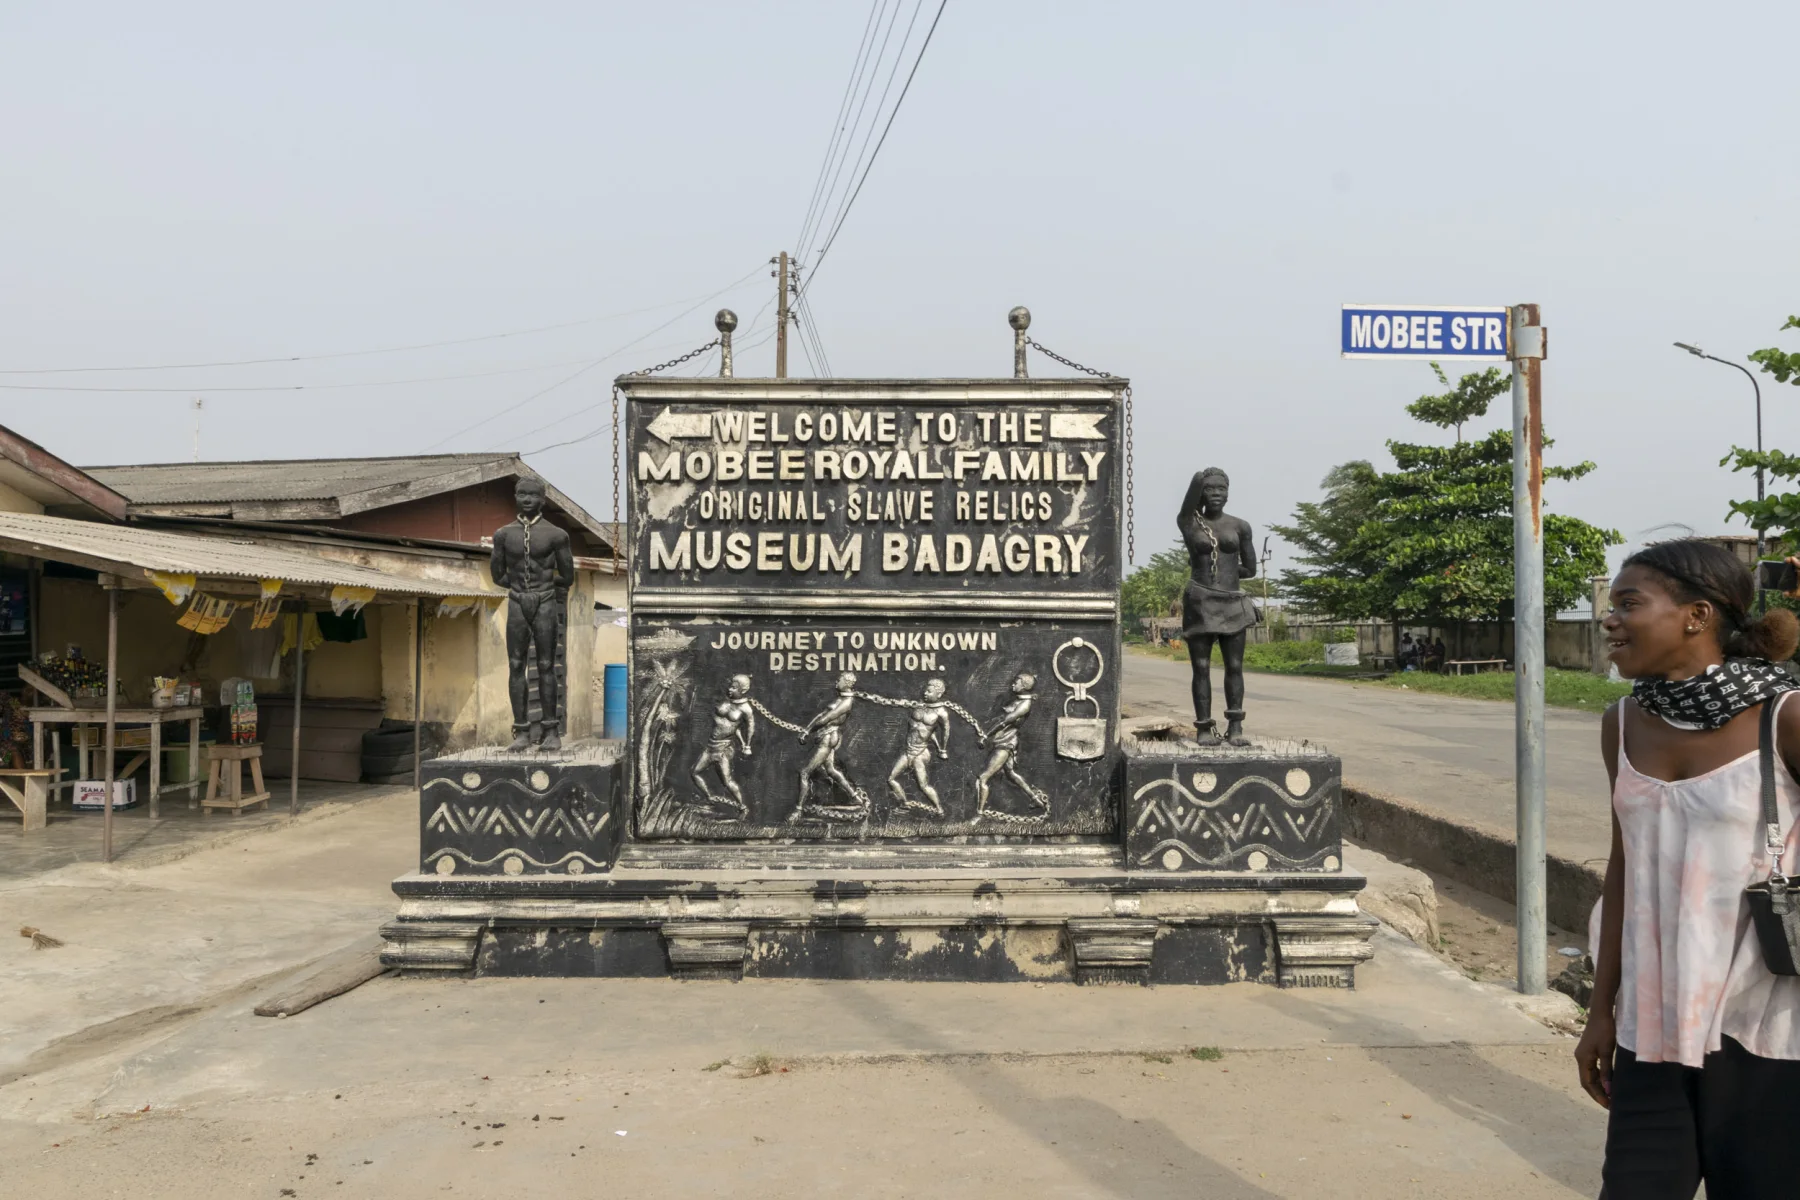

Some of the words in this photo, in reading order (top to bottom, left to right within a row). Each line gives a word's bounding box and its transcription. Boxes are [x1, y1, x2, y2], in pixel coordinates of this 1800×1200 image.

[1351, 315, 1443, 349] MOBEE
[1450, 317, 1503, 350] STR
[716, 411, 896, 442] WELCOME
[915, 412, 957, 442] TO
[976, 412, 1043, 443] THE
[638, 450, 805, 481] MOBEE
[814, 450, 944, 480] ROYAL
[953, 450, 1107, 482] FAMILY
[700, 490, 826, 521] ORIGINAL
[847, 490, 933, 521] SLAVE
[956, 490, 1053, 521] RELICS
[649, 531, 862, 572] MUSEUM
[882, 533, 1089, 573] BADAGRY
[711, 631, 826, 650] JOURNEY
[833, 631, 865, 649] TO
[873, 631, 997, 651] UNKNOWN
[769, 652, 946, 672] DESTINATION.
